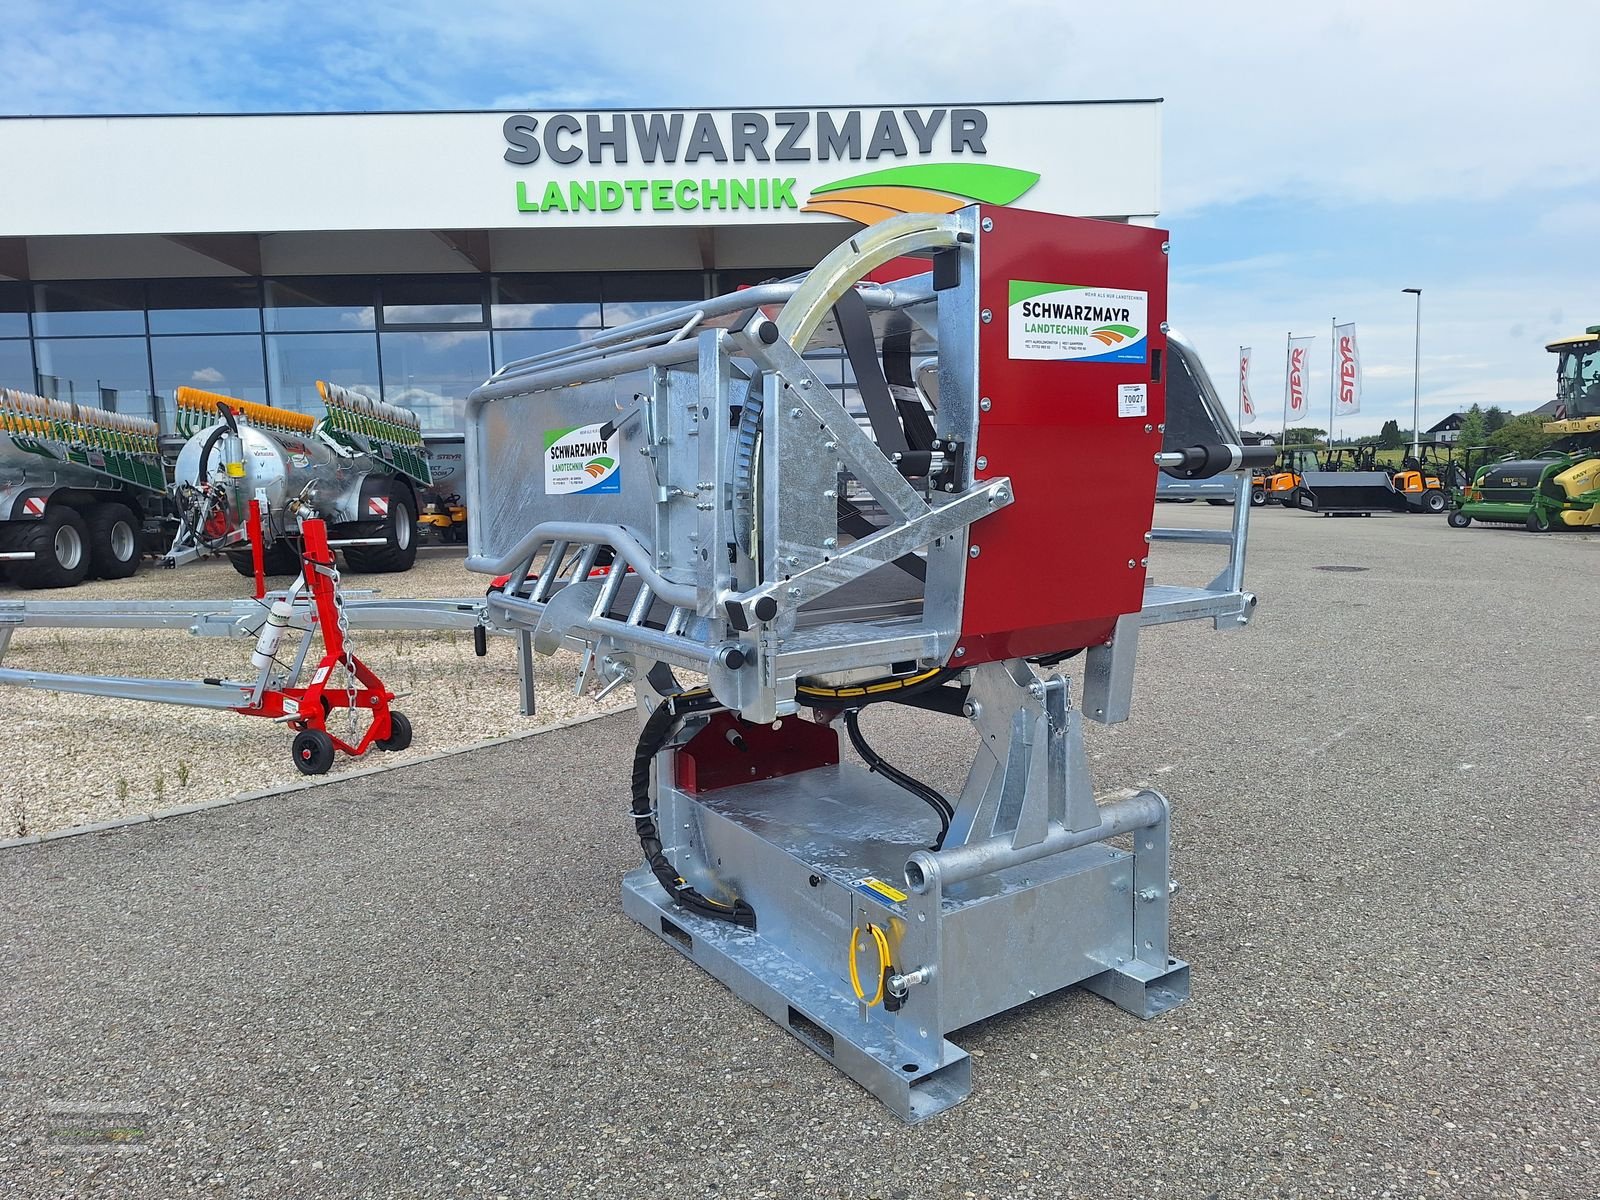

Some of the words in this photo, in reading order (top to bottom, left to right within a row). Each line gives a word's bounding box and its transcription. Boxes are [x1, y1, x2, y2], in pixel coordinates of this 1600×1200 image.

[502, 108, 989, 166] SCHWARZMAYR
[516, 177, 798, 213] LANDTECHNIK
[1022, 301, 1130, 322] SCHWARZMAYR
[1024, 323, 1089, 336] LANDTECHNIK
[1290, 348, 1304, 411] STEYR
[1340, 336, 1355, 404] STEYR
[1124, 394, 1144, 403] 70027
[550, 441, 608, 460] SCHWARZMAYR
[552, 462, 584, 472] LANDTECHNIK
